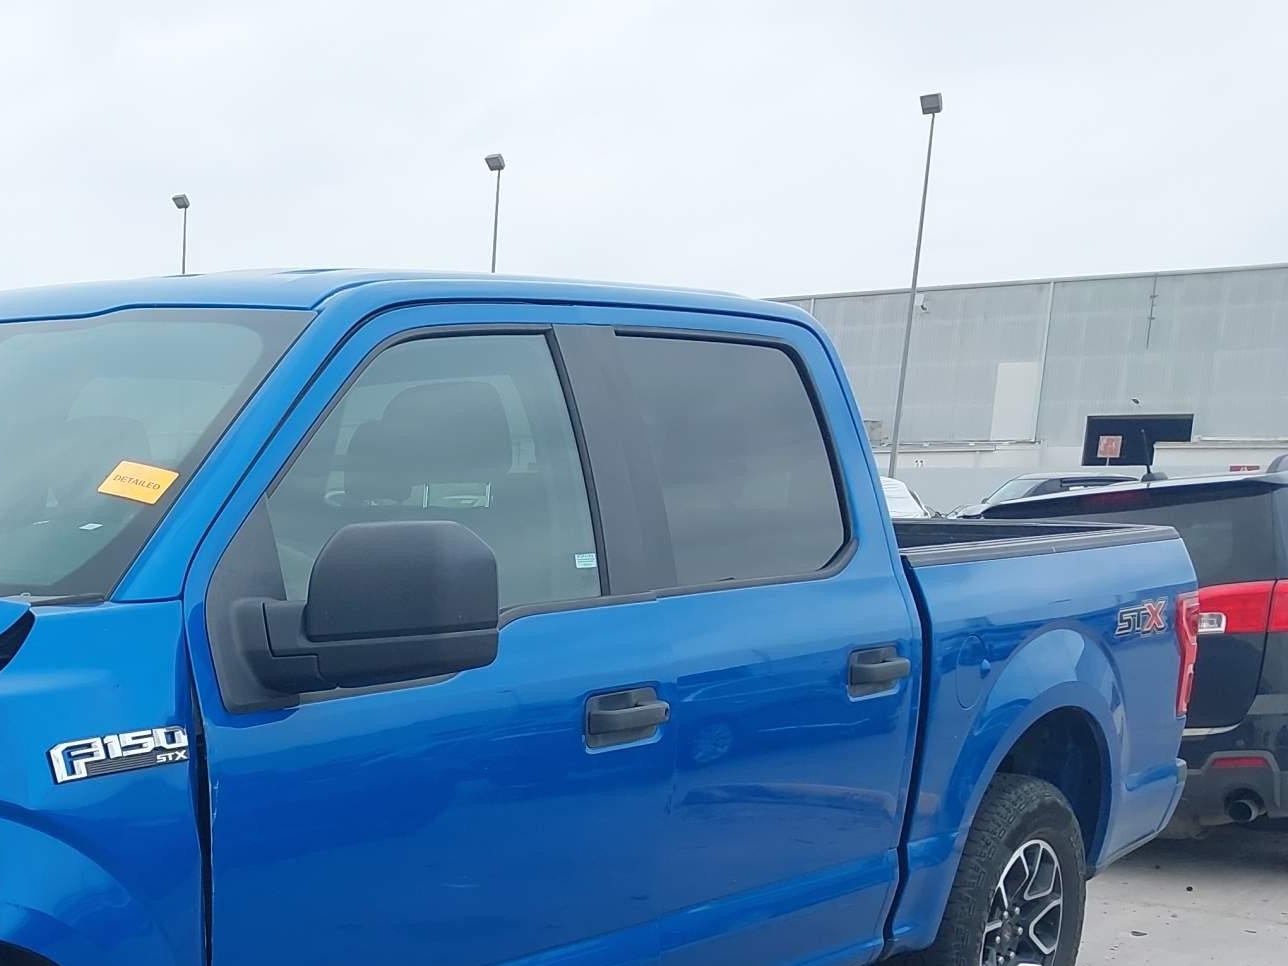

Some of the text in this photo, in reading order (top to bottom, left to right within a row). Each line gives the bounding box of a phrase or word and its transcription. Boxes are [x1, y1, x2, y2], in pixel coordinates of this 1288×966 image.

[112, 474, 161, 491] DETAILED
[1115, 600, 1166, 635] STX
[156, 750, 188, 763] STX
